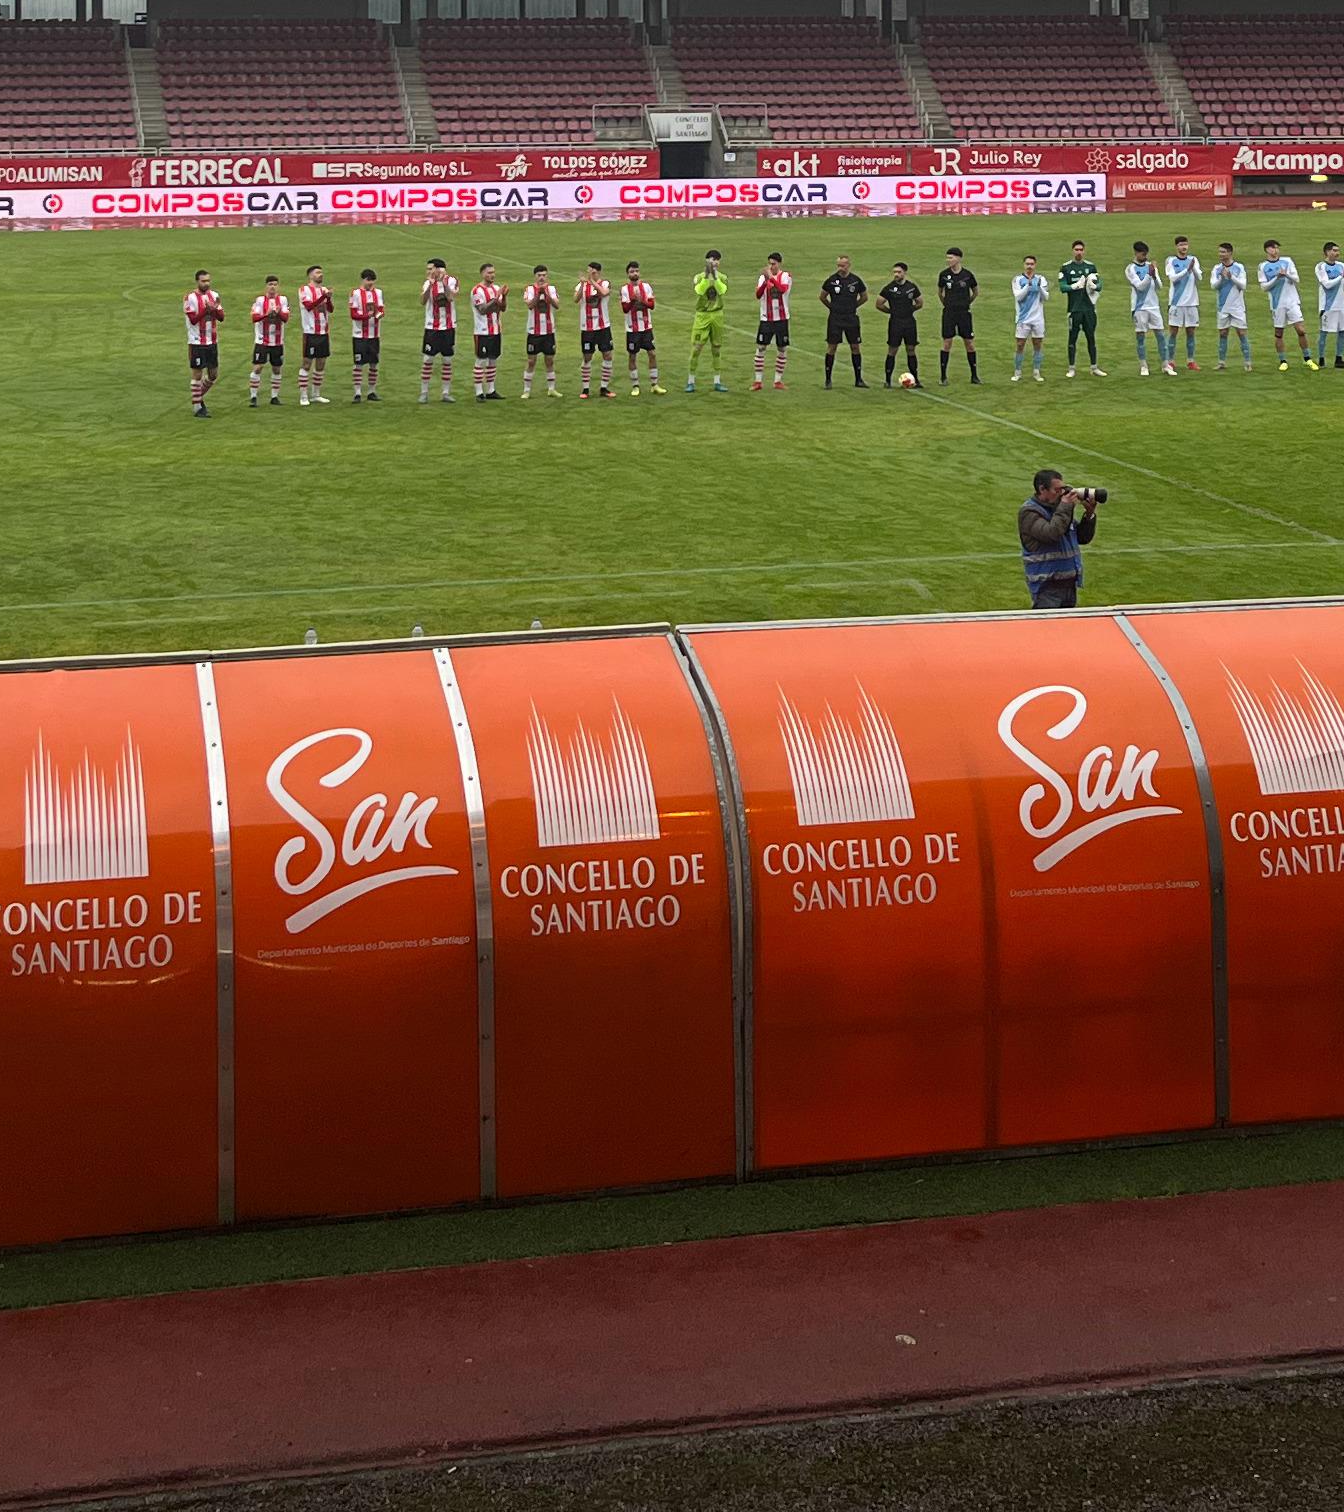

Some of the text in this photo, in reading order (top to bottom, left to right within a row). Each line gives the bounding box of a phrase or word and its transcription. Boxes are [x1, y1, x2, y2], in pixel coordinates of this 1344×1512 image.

[364, 162, 420, 180] Segundo
[423, 161, 446, 179] Rey
[449, 161, 472, 176] S.L.
[542, 152, 647, 168] TOLDOS GÓMEZ
[774, 151, 820, 177] akt
[837, 155, 902, 167] fisioterapia
[848, 166, 880, 175] salud
[929, 148, 963, 176] JR
[969, 150, 1042, 167] Julio Rey
[1116, 148, 1189, 173] salgado
[1232, 145, 1344, 173] Alcampo
[150, 158, 289, 186] FERRECAL
[331, 188, 549, 209] COMPOSCAR
[620, 183, 828, 204] COMPOSCAR
[895, 180, 1096, 201] COMPOSCAR
[1128, 181, 1213, 192] CONCELLO DE SANTIAGO
[92, 191, 319, 213] COMPOSCAR
[997, 685, 1161, 838] San
[267, 728, 439, 895] San
[763, 833, 960, 875] CONCELLO DE
[500, 853, 706, 898] CONCELLO DE
[793, 872, 937, 913] SANTIAGO
[164, 891, 203, 924] DE
[531, 895, 681, 936] SANTIAGO
[11, 935, 174, 976] SANTIAGO
